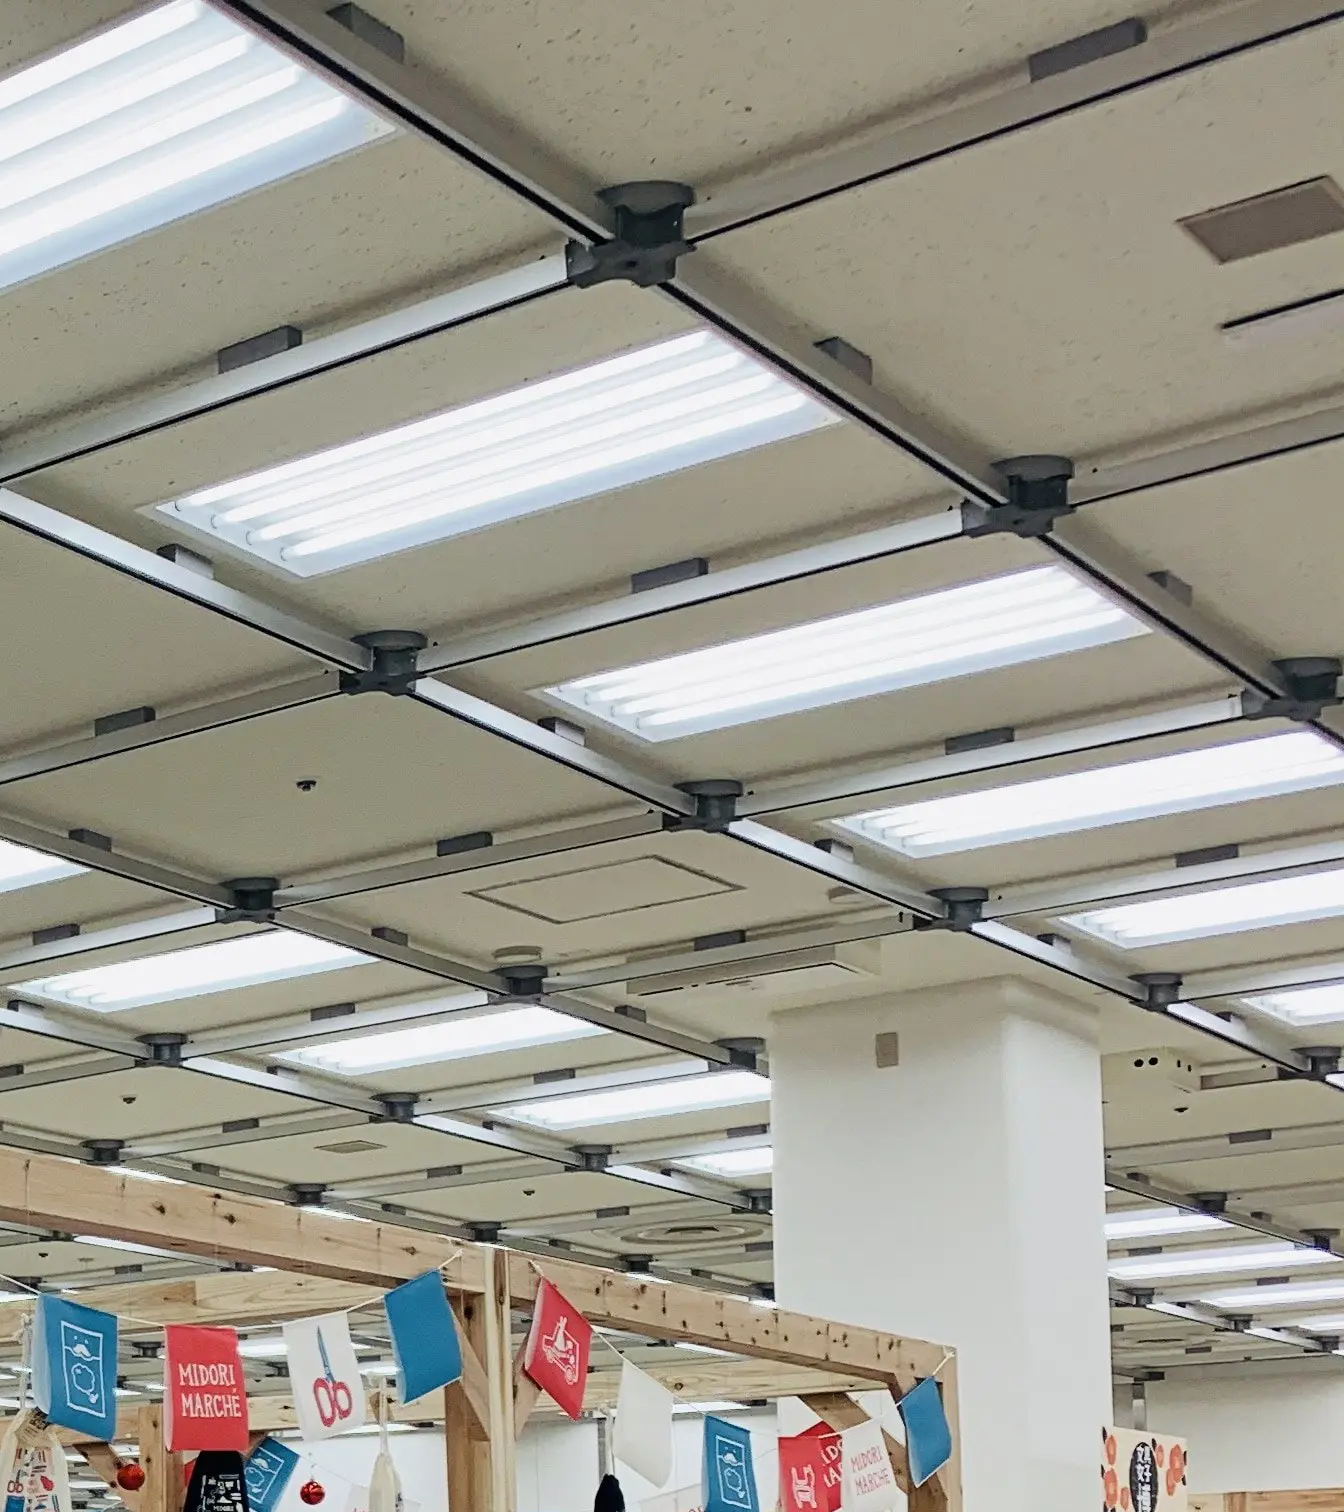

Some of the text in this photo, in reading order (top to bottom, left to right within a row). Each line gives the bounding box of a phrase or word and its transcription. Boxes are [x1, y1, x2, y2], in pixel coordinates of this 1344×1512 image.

[178, 1362, 237, 1388] MIDORI
[181, 1388, 242, 1419] MARCHÉ
[851, 1445, 883, 1473] MIDORI
